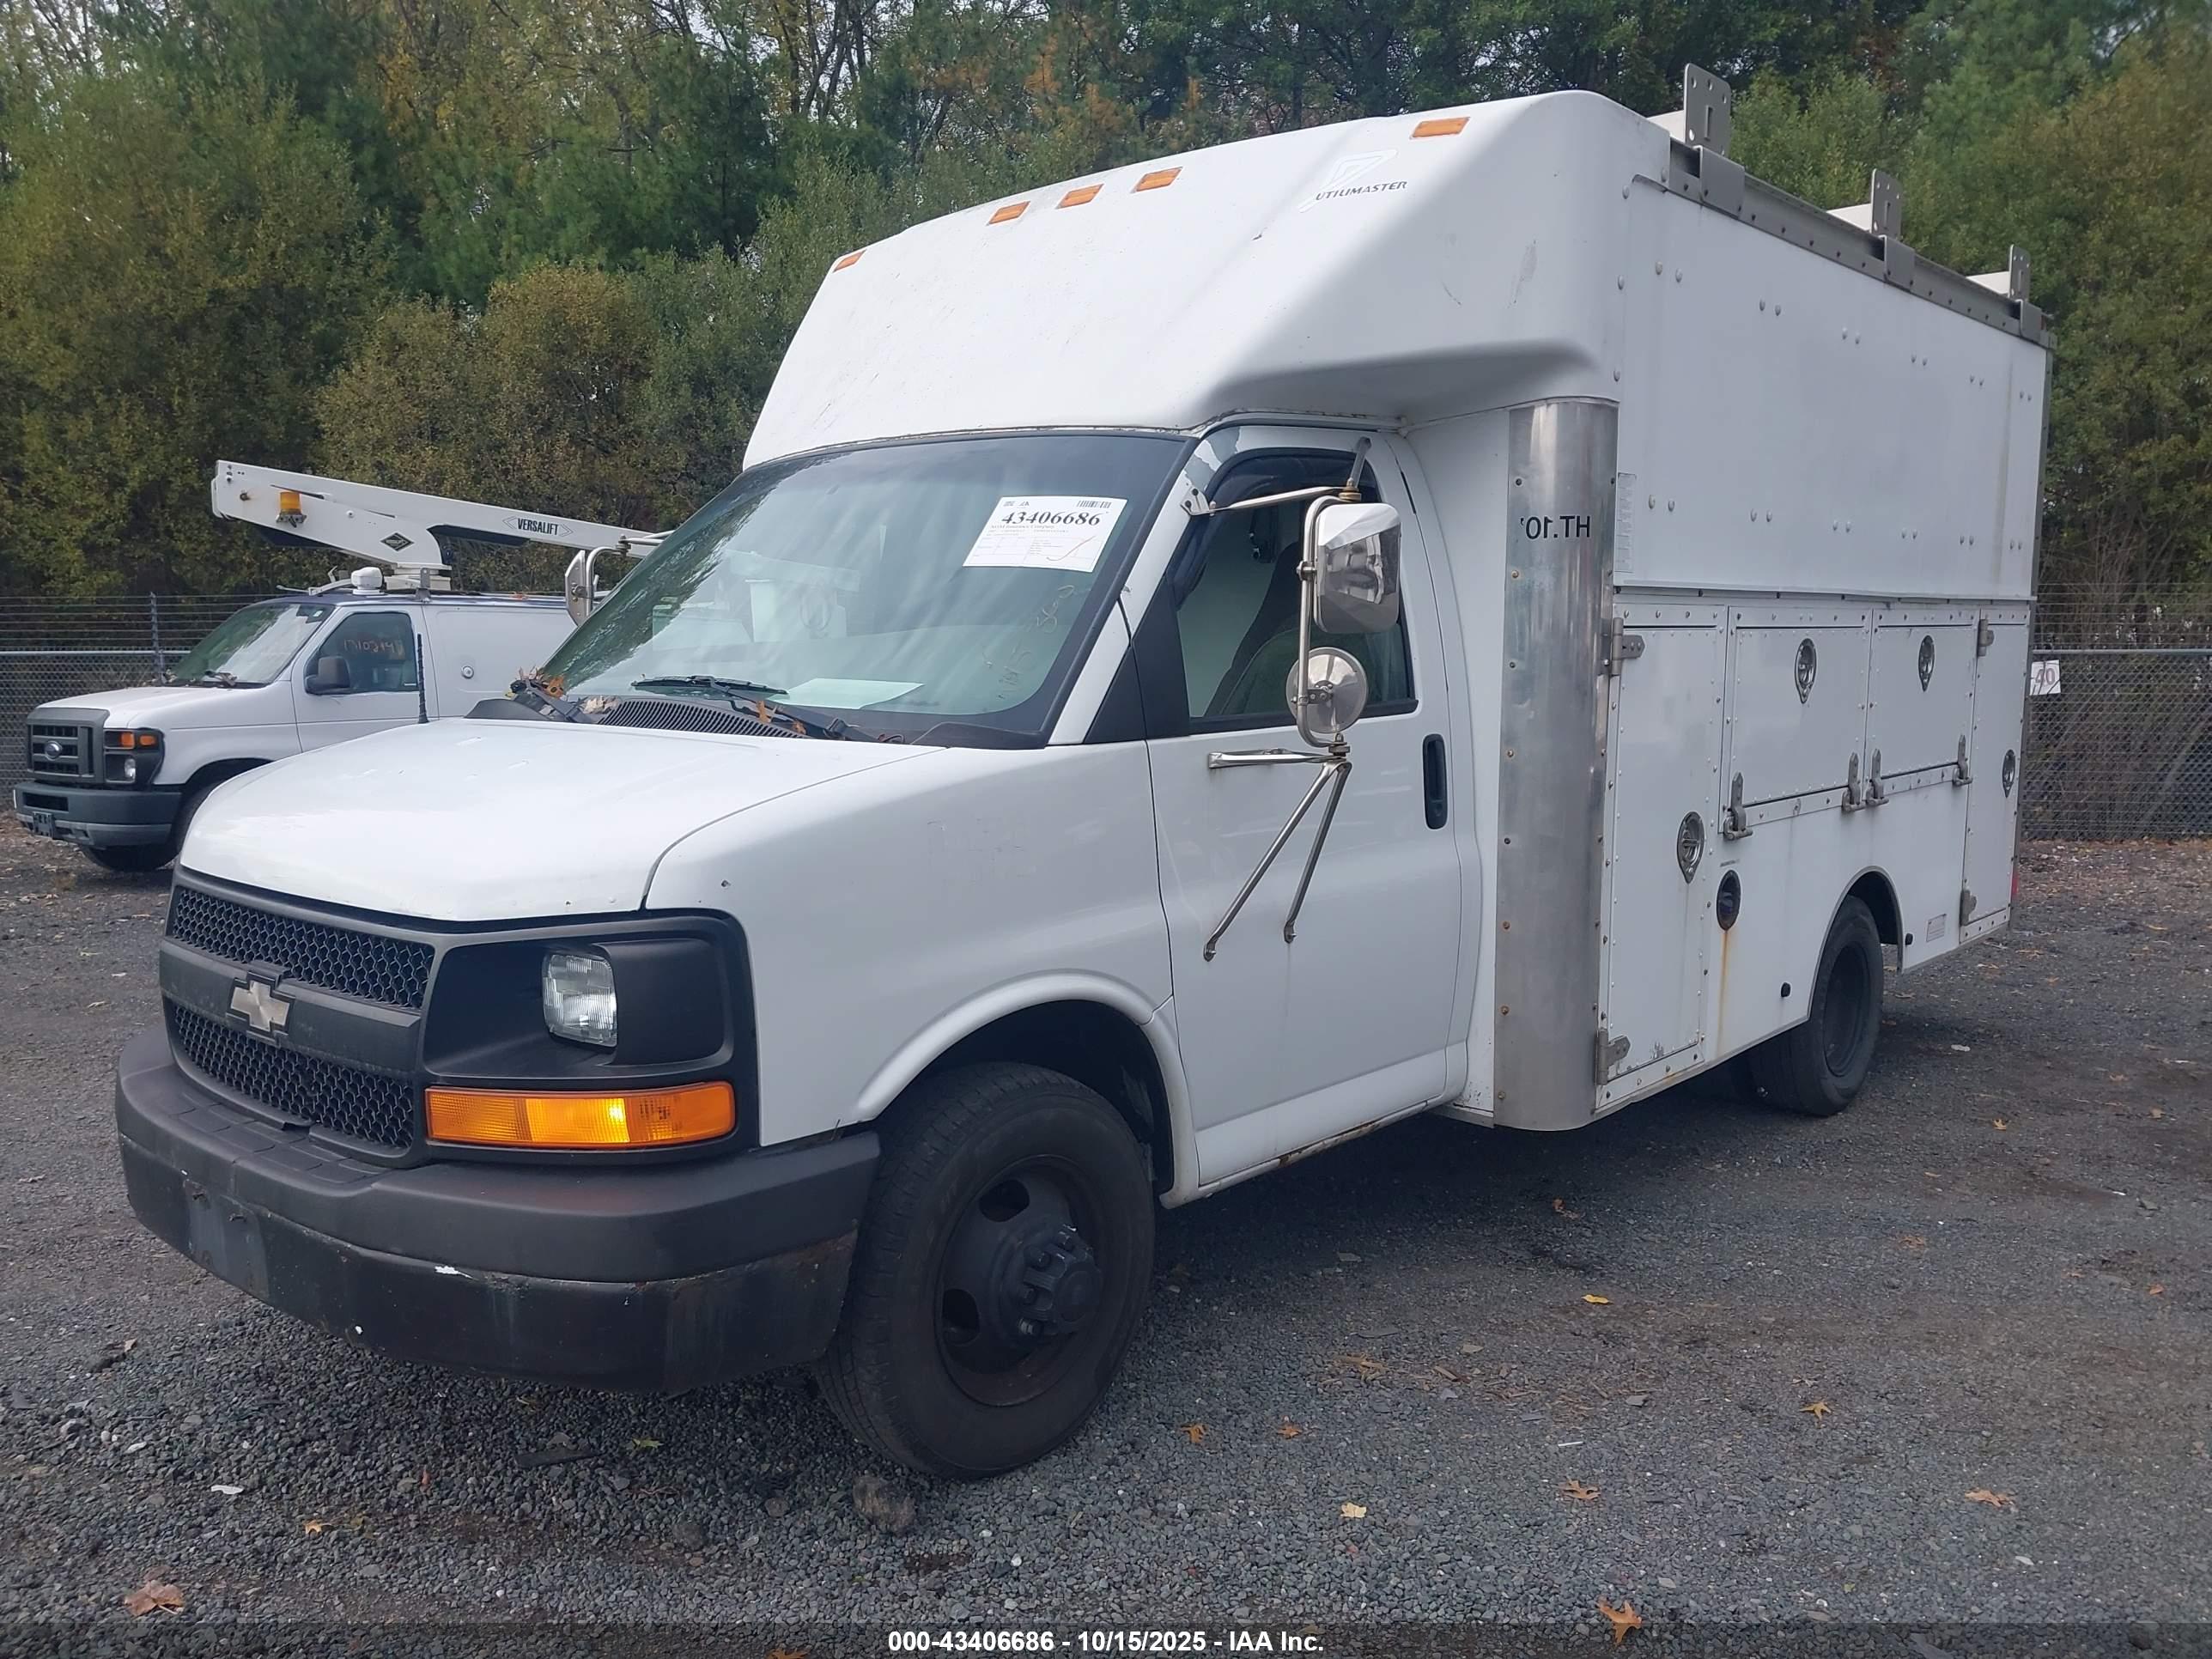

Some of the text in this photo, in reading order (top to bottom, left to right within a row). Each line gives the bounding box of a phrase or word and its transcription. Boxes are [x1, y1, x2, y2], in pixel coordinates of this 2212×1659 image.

[1316, 180, 1408, 201] UTILIMASTER
[517, 517, 559, 536] VERSALIFT
[1001, 510, 1101, 526] 43406686
